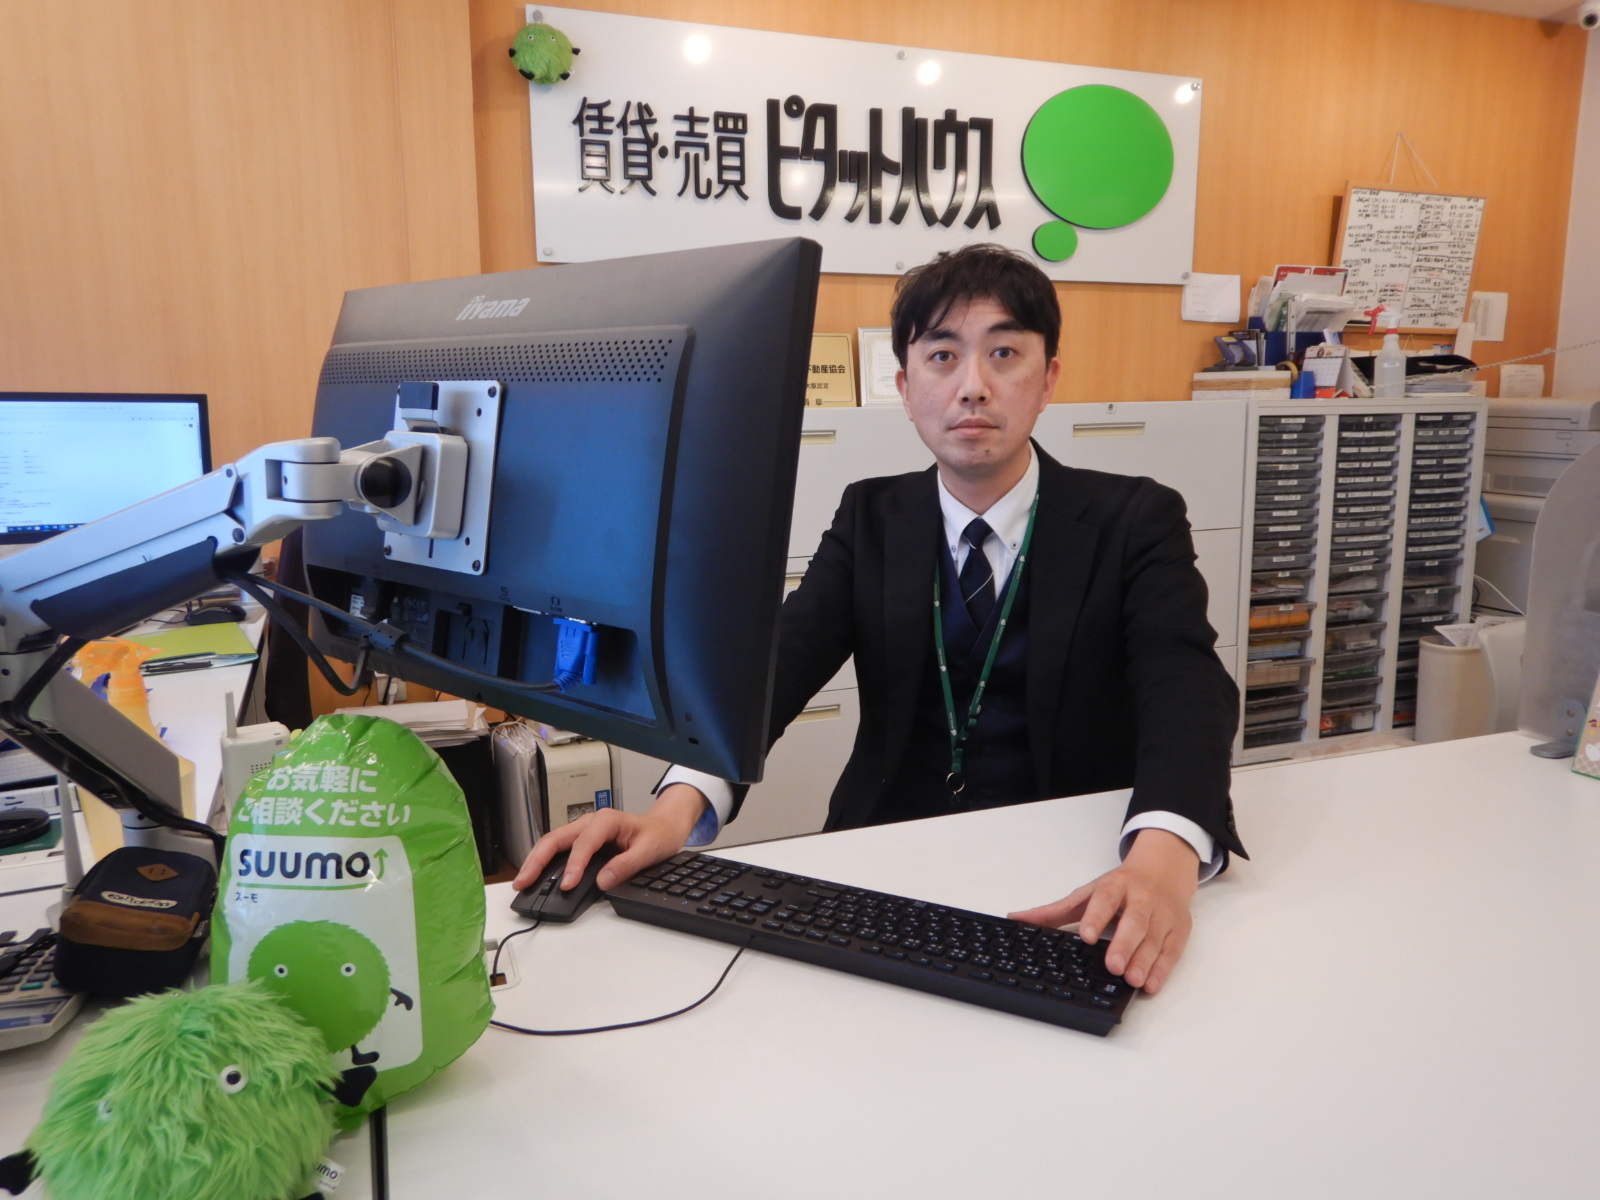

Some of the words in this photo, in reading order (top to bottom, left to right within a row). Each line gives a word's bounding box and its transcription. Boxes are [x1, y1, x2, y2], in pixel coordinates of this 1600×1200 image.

[572, 96, 750, 201] 賃貸・売買
[766, 94, 1002, 231] ピタットハウス
[455, 294, 531, 321] iiyama
[266, 765, 379, 793] お気軽に
[238, 796, 411, 828] ご相談ください
[235, 892, 259, 904] スーモ
